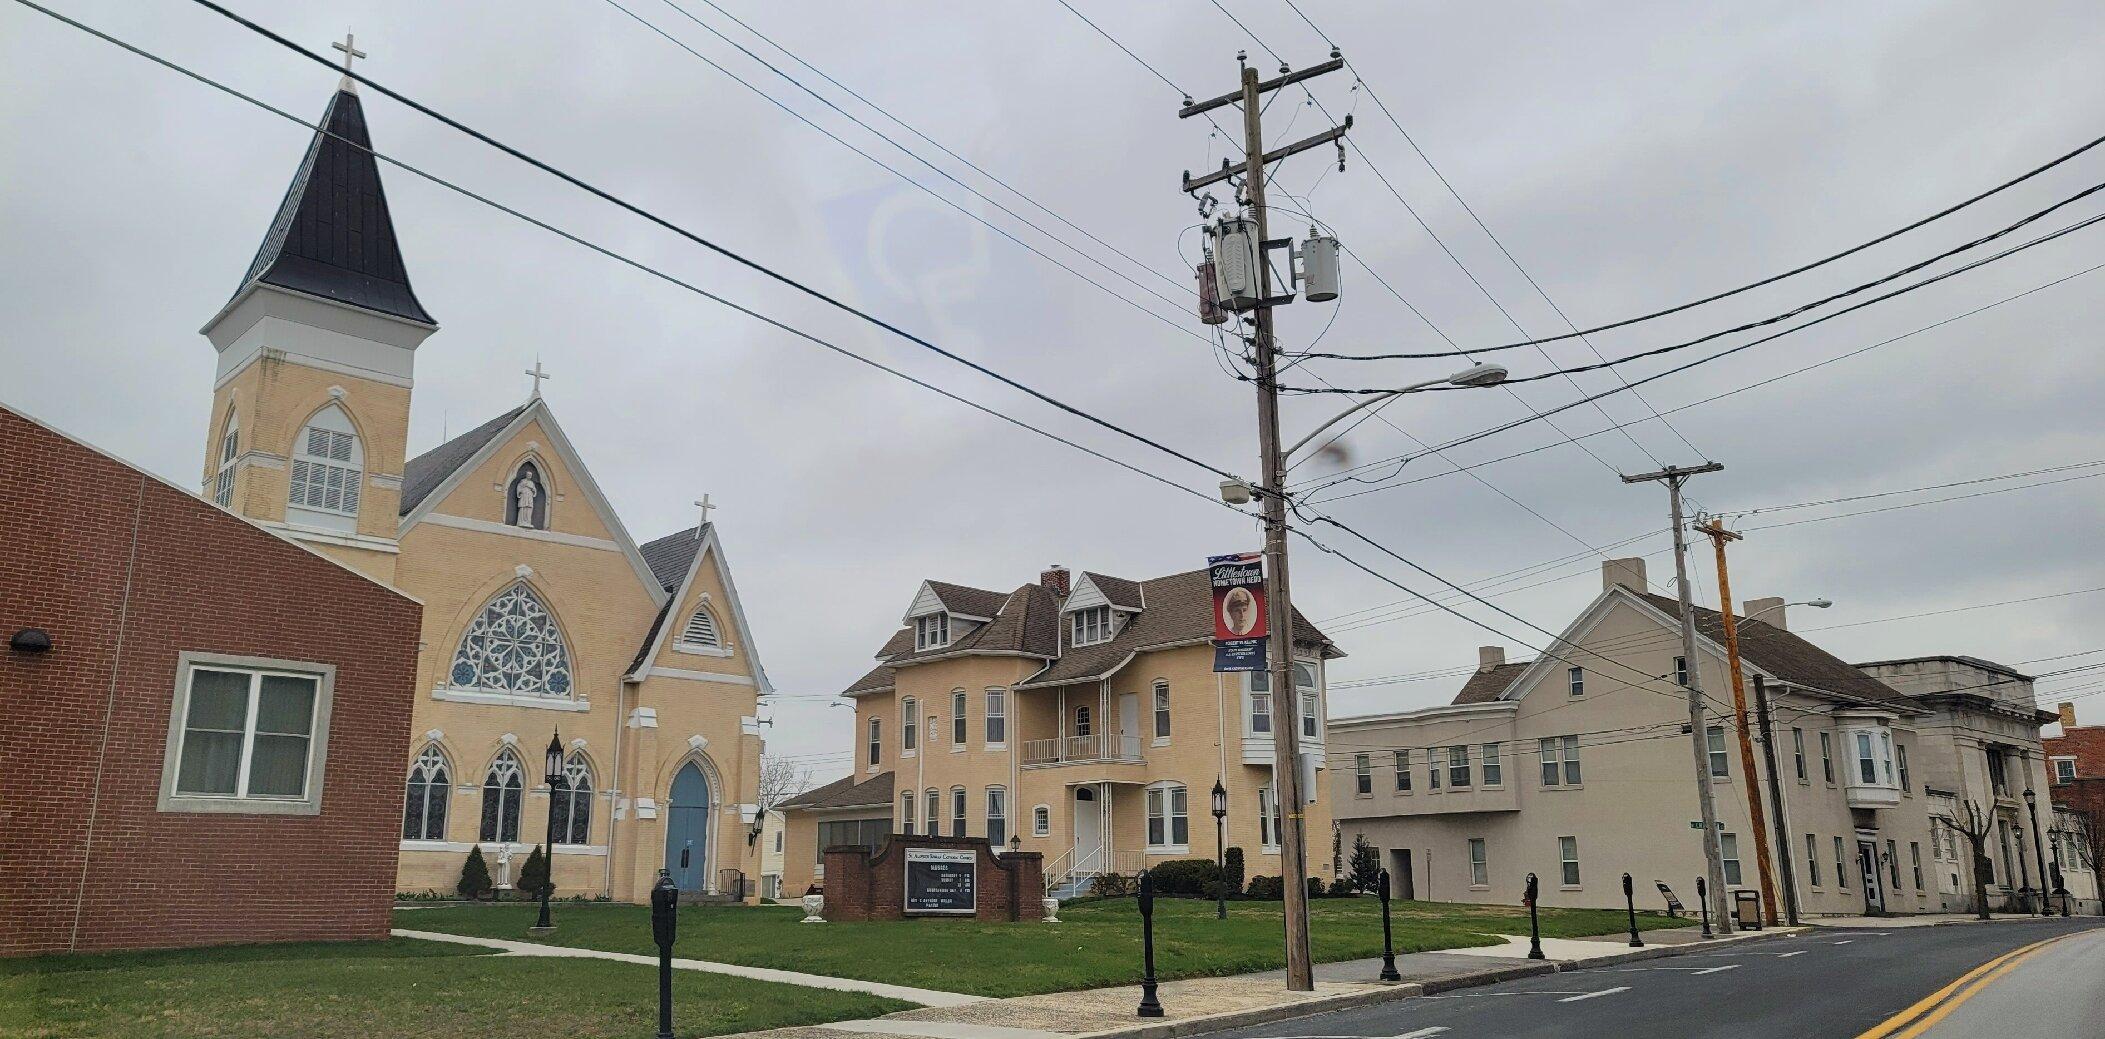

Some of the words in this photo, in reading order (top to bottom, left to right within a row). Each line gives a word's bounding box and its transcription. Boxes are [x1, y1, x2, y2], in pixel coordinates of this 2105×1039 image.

[1213, 565, 1260, 580] Littlestown
[1213, 577, 1246, 587] HOMETOWN
[1246, 575, 1262, 584] HERO
